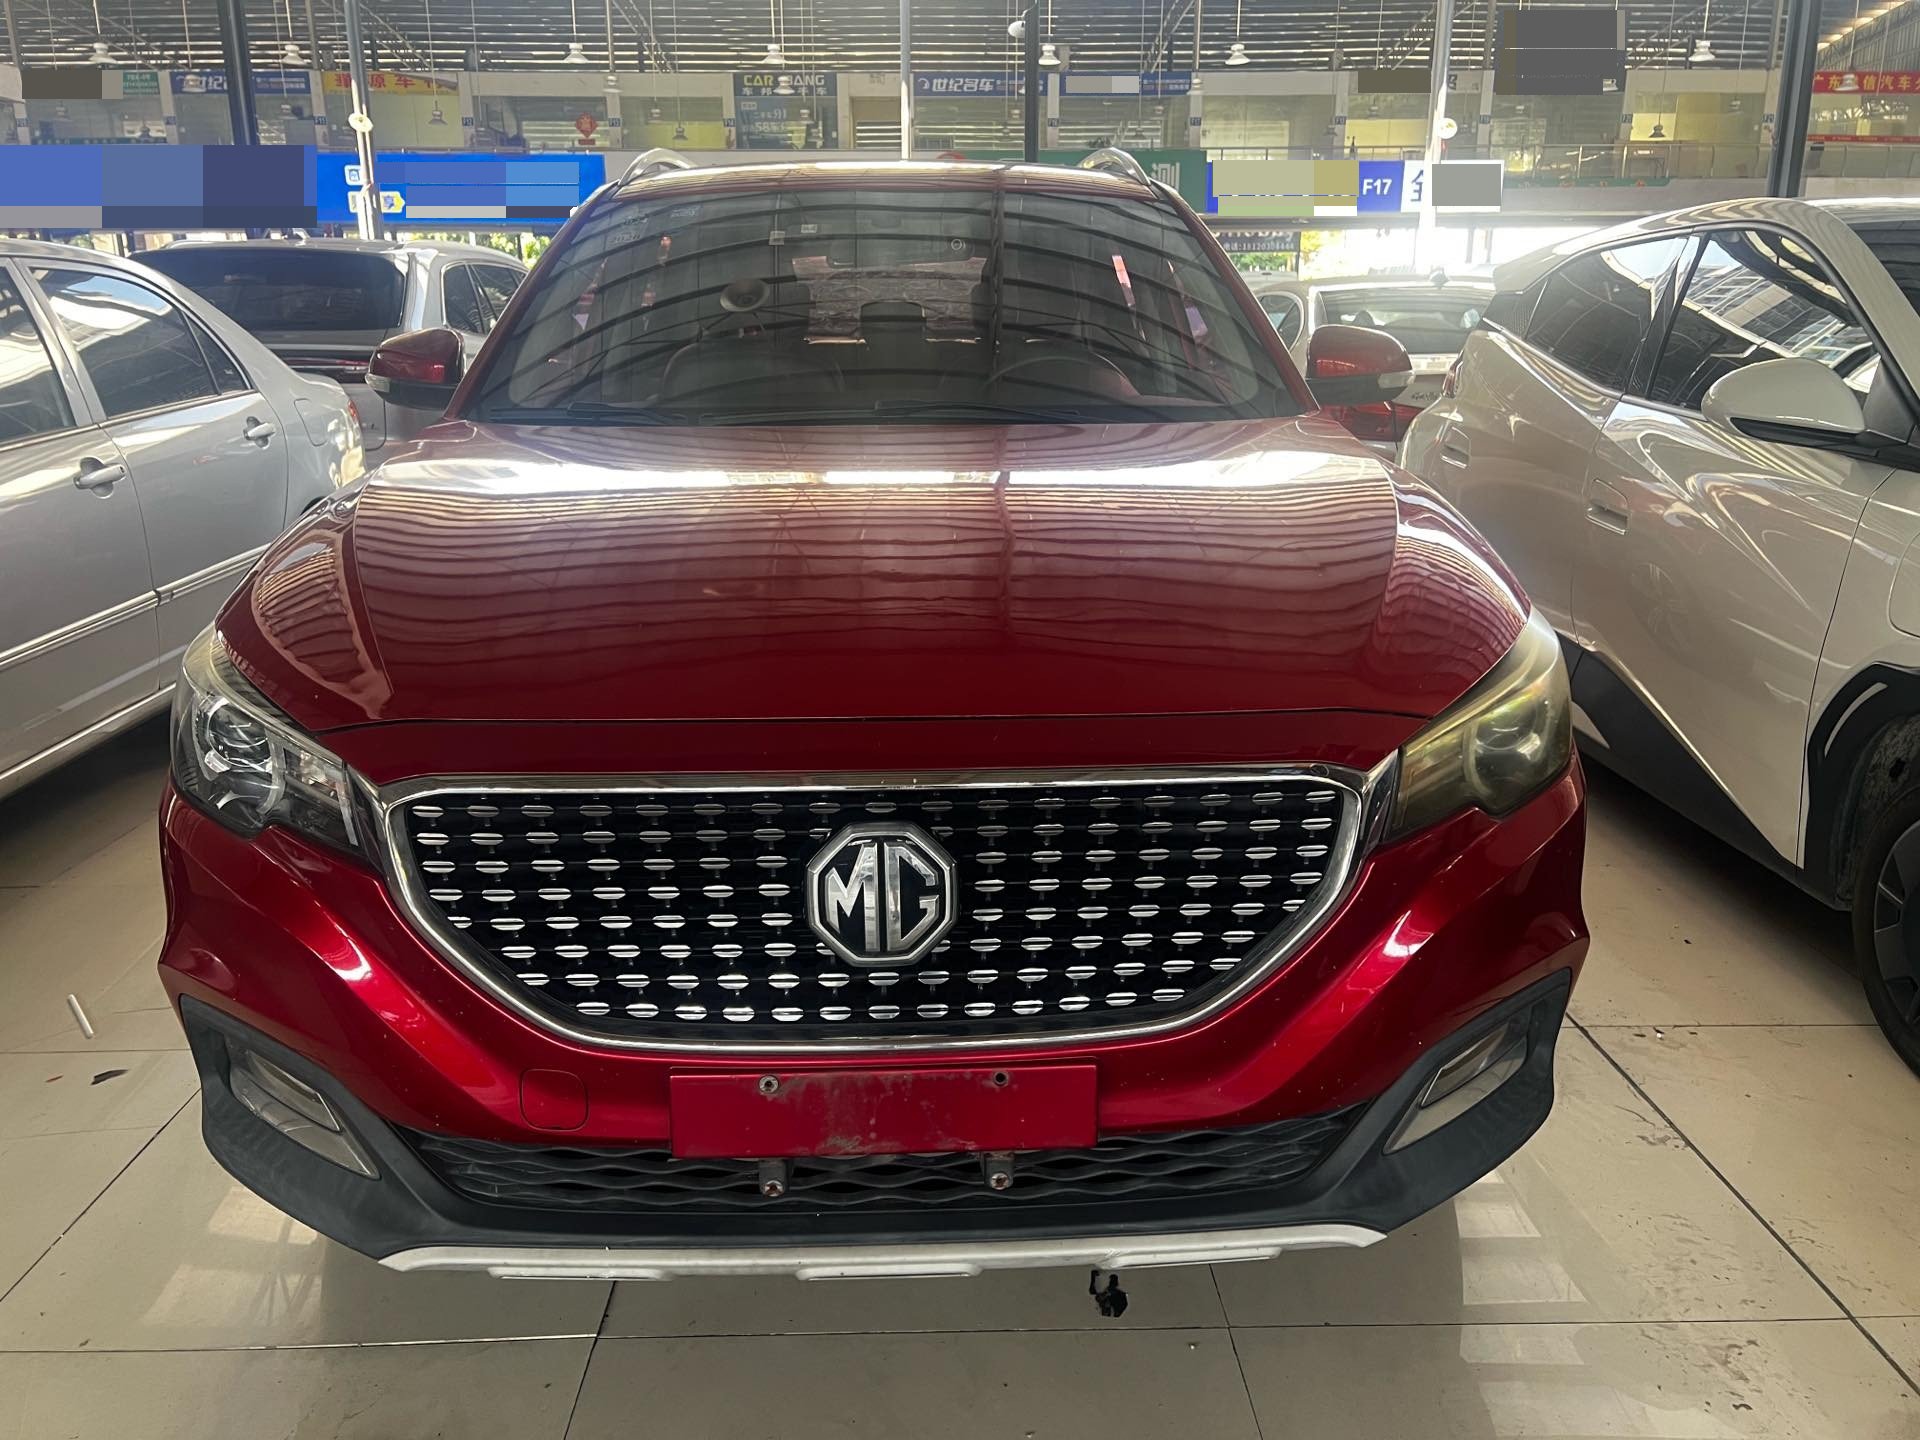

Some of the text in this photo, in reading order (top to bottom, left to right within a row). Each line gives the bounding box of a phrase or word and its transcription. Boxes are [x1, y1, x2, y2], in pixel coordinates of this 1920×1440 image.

[744, 75, 774, 86] CAR
[932, 78, 994, 92] 世纪名车
[742, 87, 827, 96] 车邦手车
[1362, 178, 1393, 195] F17
[825, 842, 939, 952] MG
